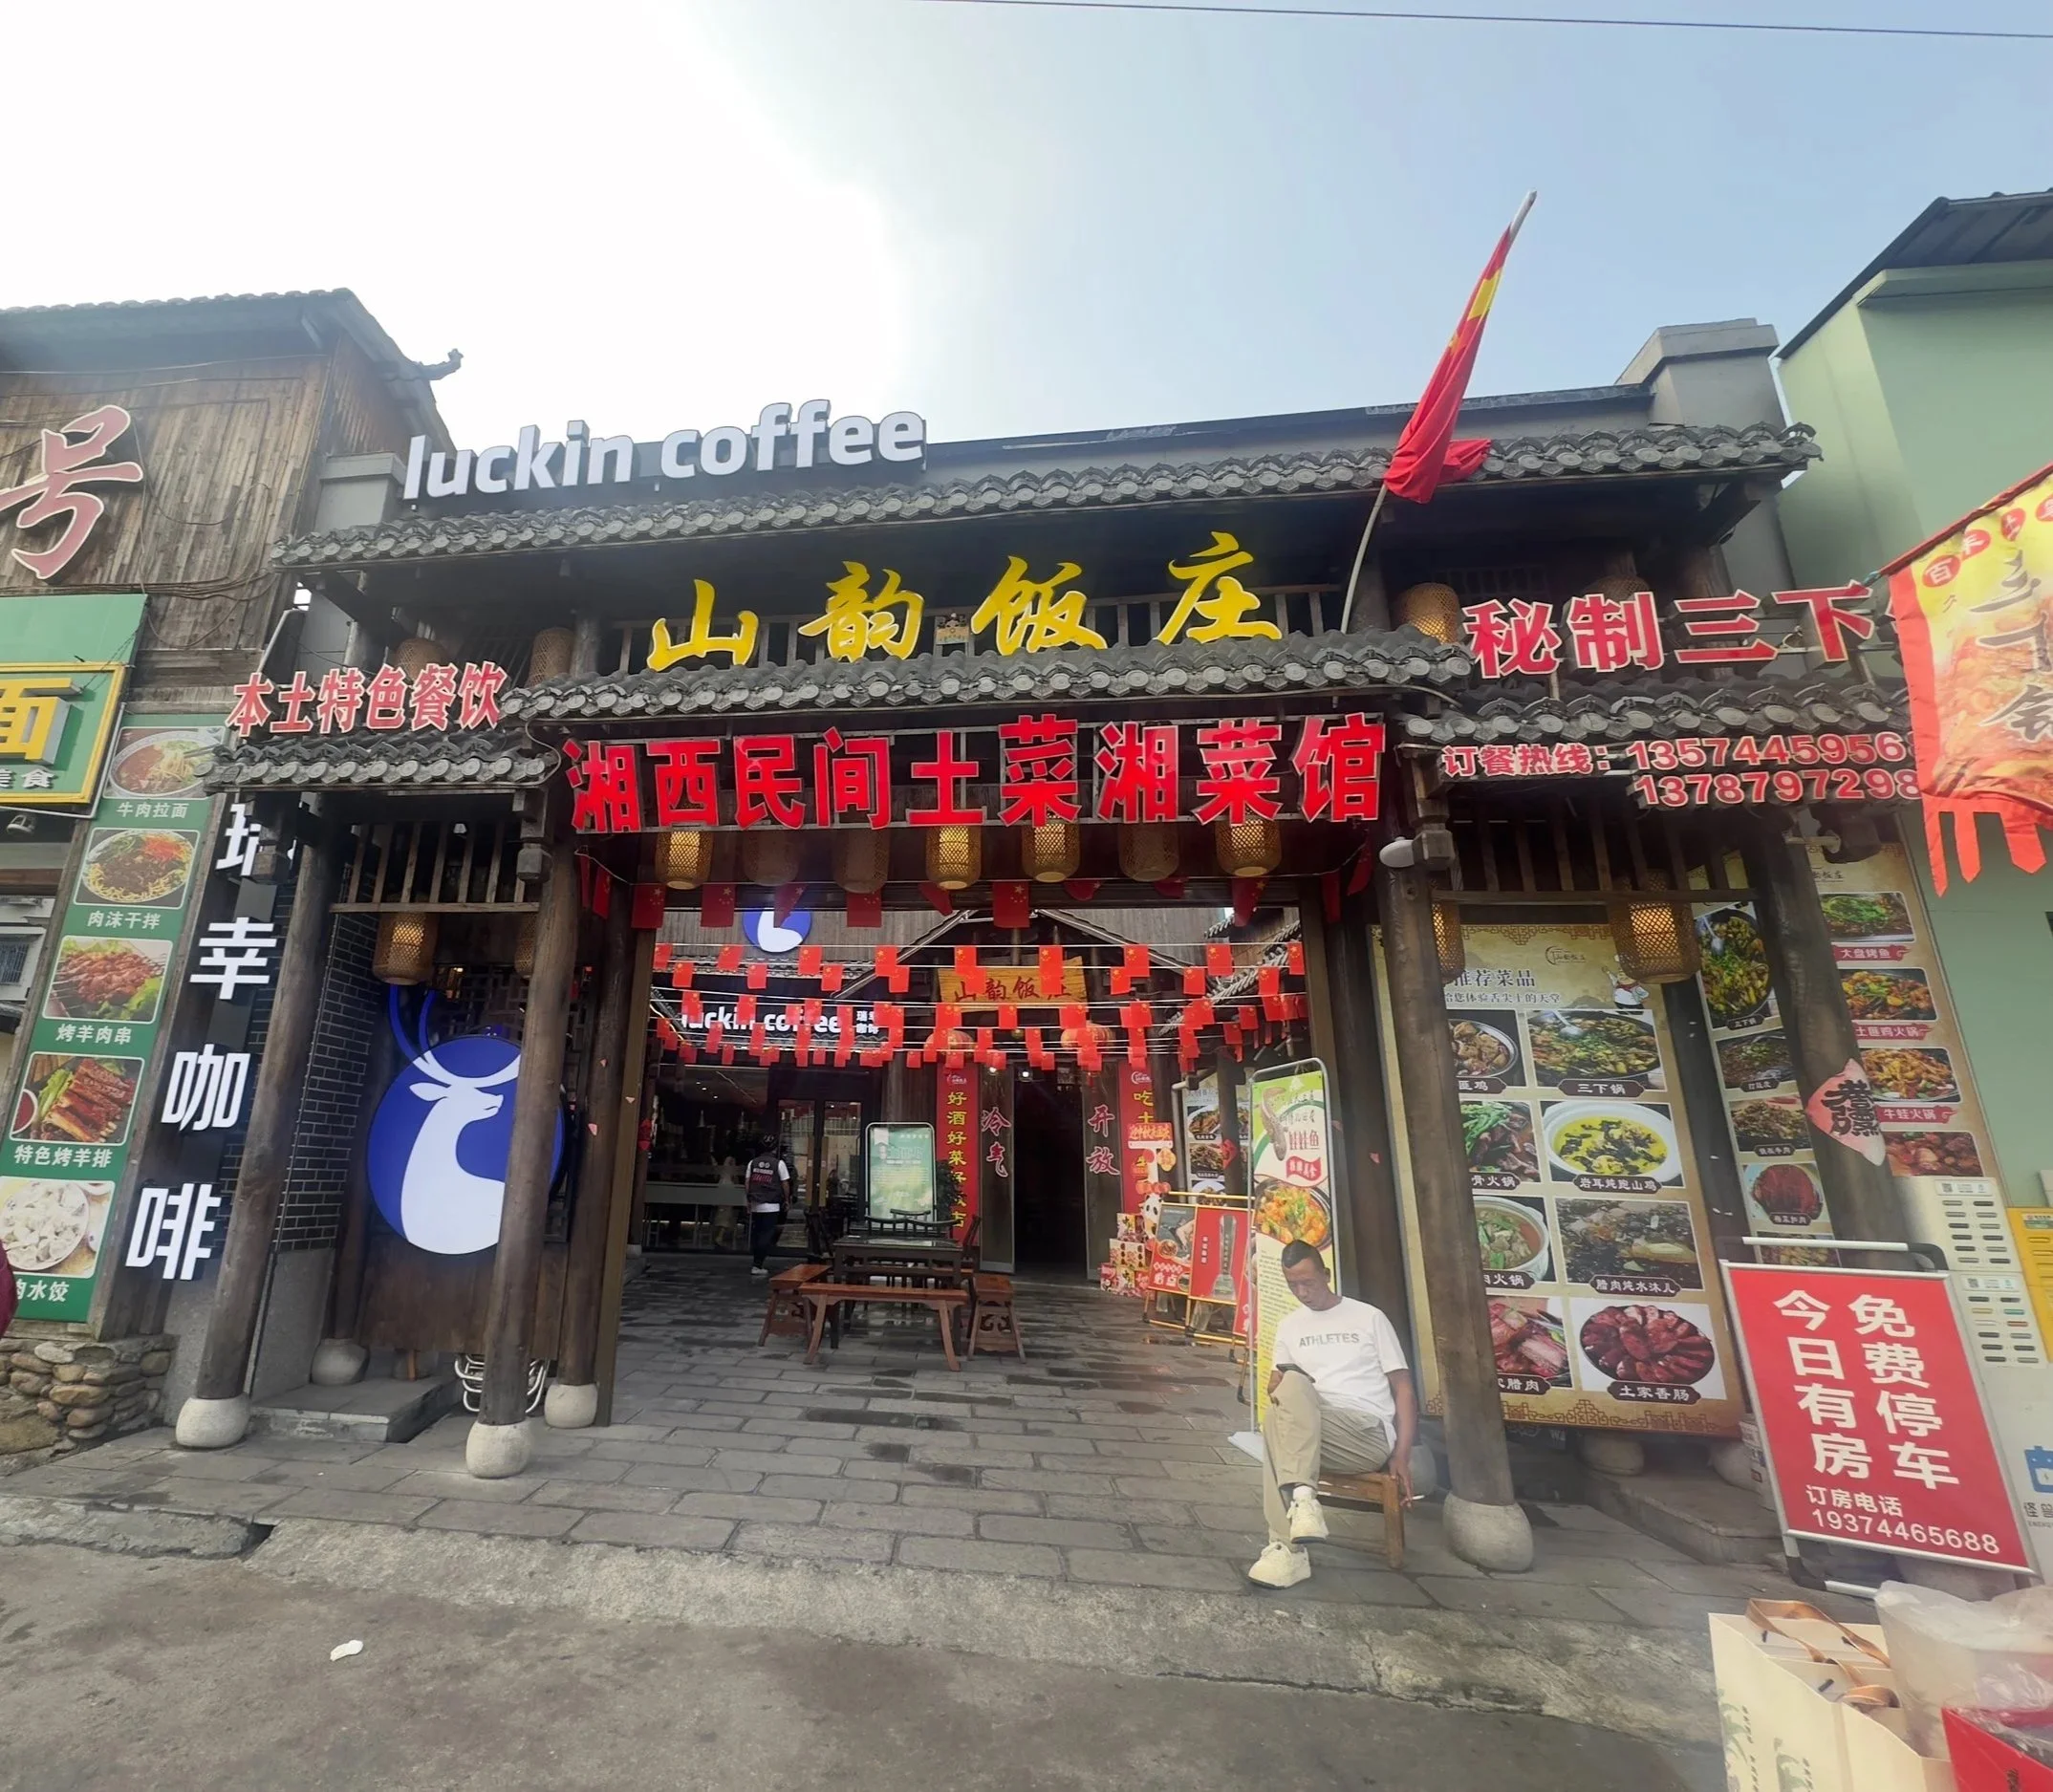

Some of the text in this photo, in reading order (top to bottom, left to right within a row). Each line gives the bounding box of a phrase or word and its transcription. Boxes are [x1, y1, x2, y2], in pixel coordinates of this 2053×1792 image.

[402, 399, 926, 499] luckin coffee
[647, 531, 1283, 672] 山韵饭庄
[1462, 579, 1898, 680] 秘制三下
[227, 661, 508, 737] 本土特色餐饮
[1627, 731, 1914, 771] 1357445956
[561, 712, 1388, 833] 湘西民间土菜湘菜馆
[117, 802, 189, 819] 牛肉拉面
[87, 911, 161, 930] 肉沫干拌
[1841, 948, 1890, 959] 大盘烤鱼
[1454, 969, 1535, 987] 推荐菜品
[55, 1024, 132, 1045] 烤羊肉串
[1856, 1026, 1919, 1037] 土匪鸡火锅
[1577, 1083, 1626, 1096] 三下锅
[1884, 1109, 1936, 1120] 牛蛙火锅
[13, 1144, 113, 1168] 特色烤羊排
[982, 1107, 1011, 1177] 冷气
[1086, 1104, 1121, 1176] 开放
[1299, 1332, 1360, 1348] ATHLETES
[1619, 1386, 1690, 1402] 土家香肠
[1773, 1289, 1873, 1479] 今日有房
[1848, 1294, 1959, 1490] 免费停车
[1805, 1484, 1904, 1518] 订房电话
[1812, 1508, 2001, 1556] 19374465688
